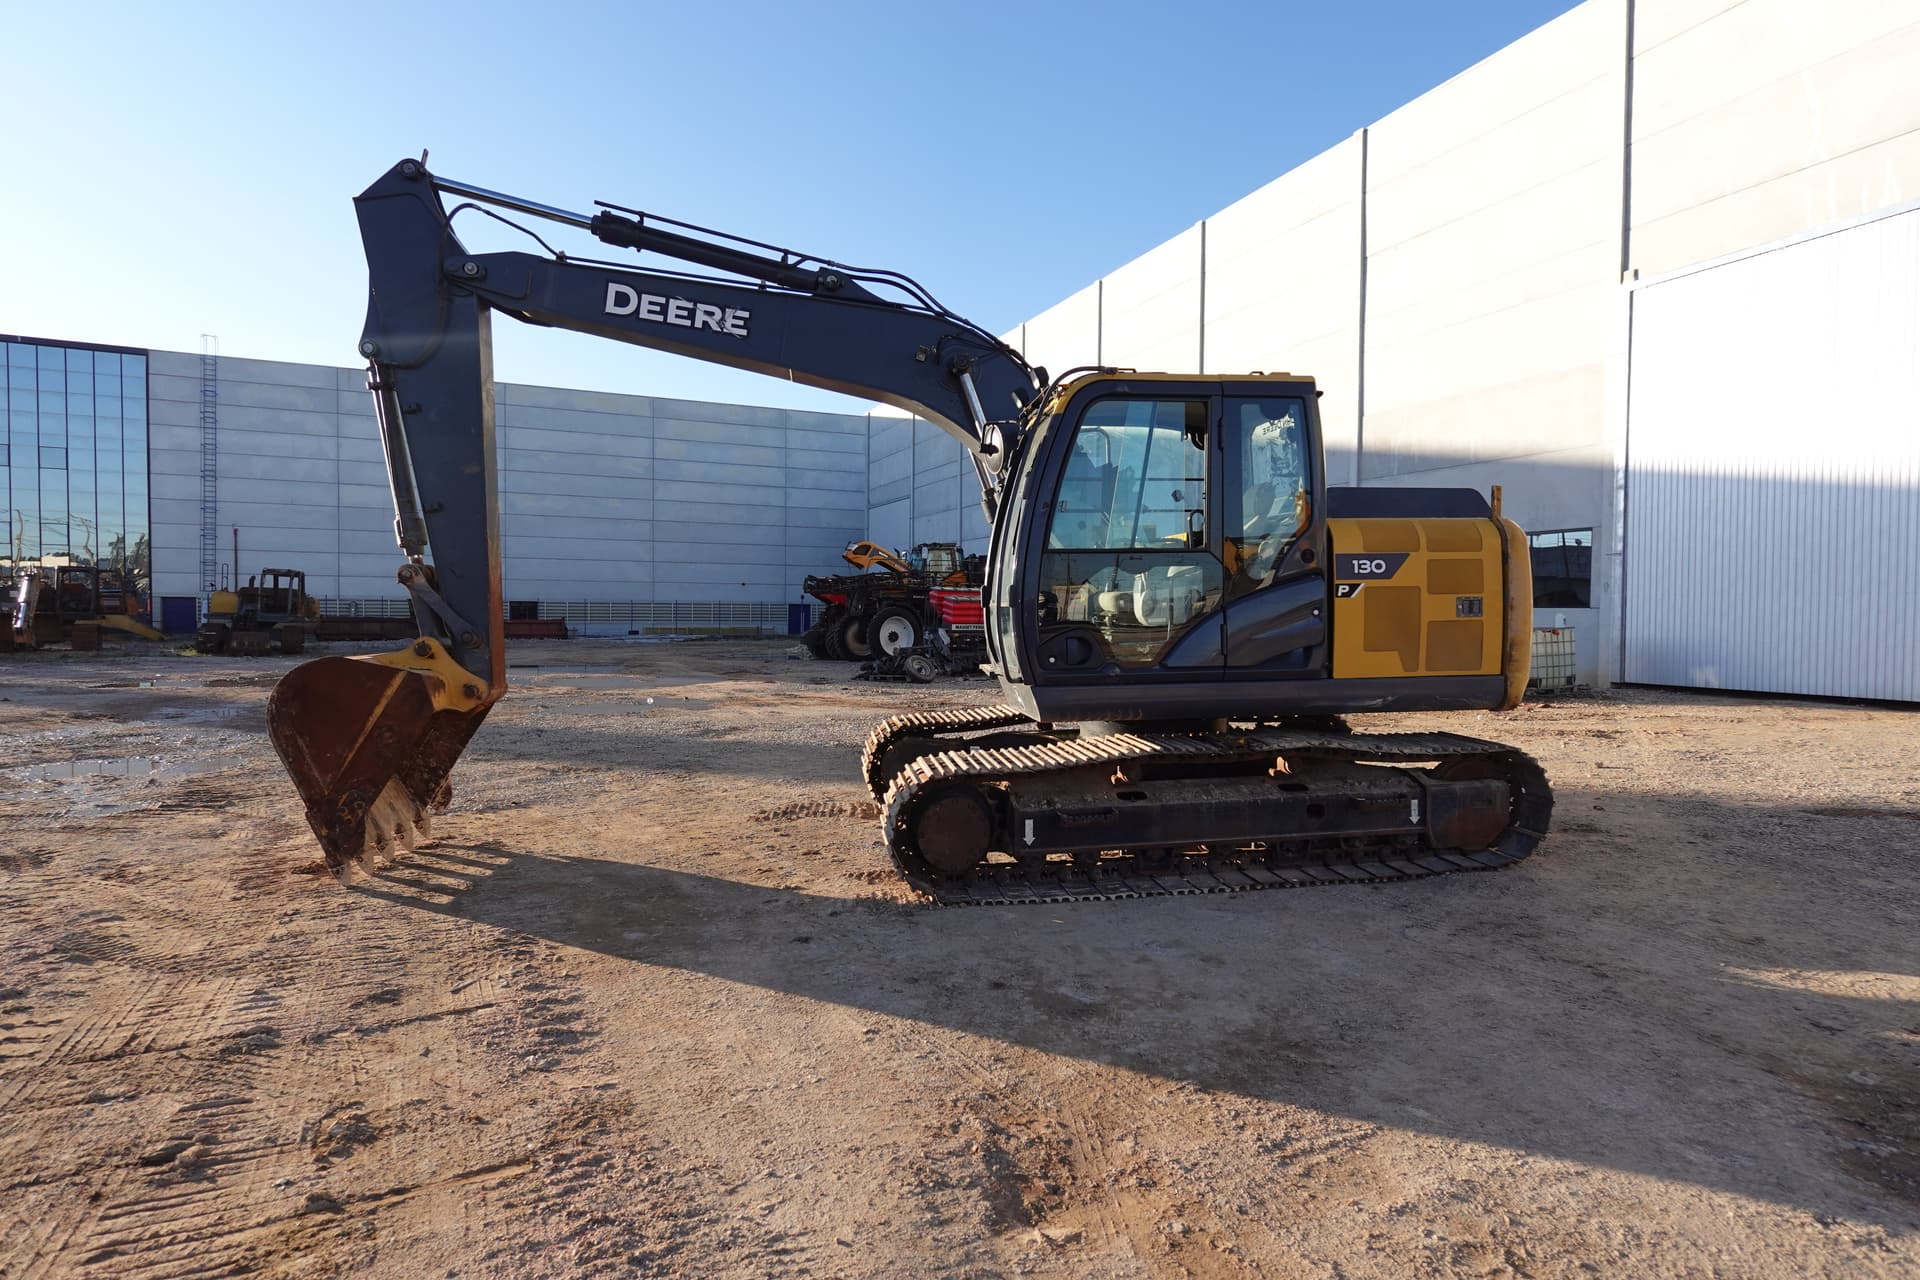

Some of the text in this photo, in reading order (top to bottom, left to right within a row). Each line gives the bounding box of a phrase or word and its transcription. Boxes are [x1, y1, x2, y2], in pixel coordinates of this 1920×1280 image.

[605, 282, 750, 336] DEERE
[1352, 559, 1386, 574] 130
[1337, 584, 1350, 597] P
